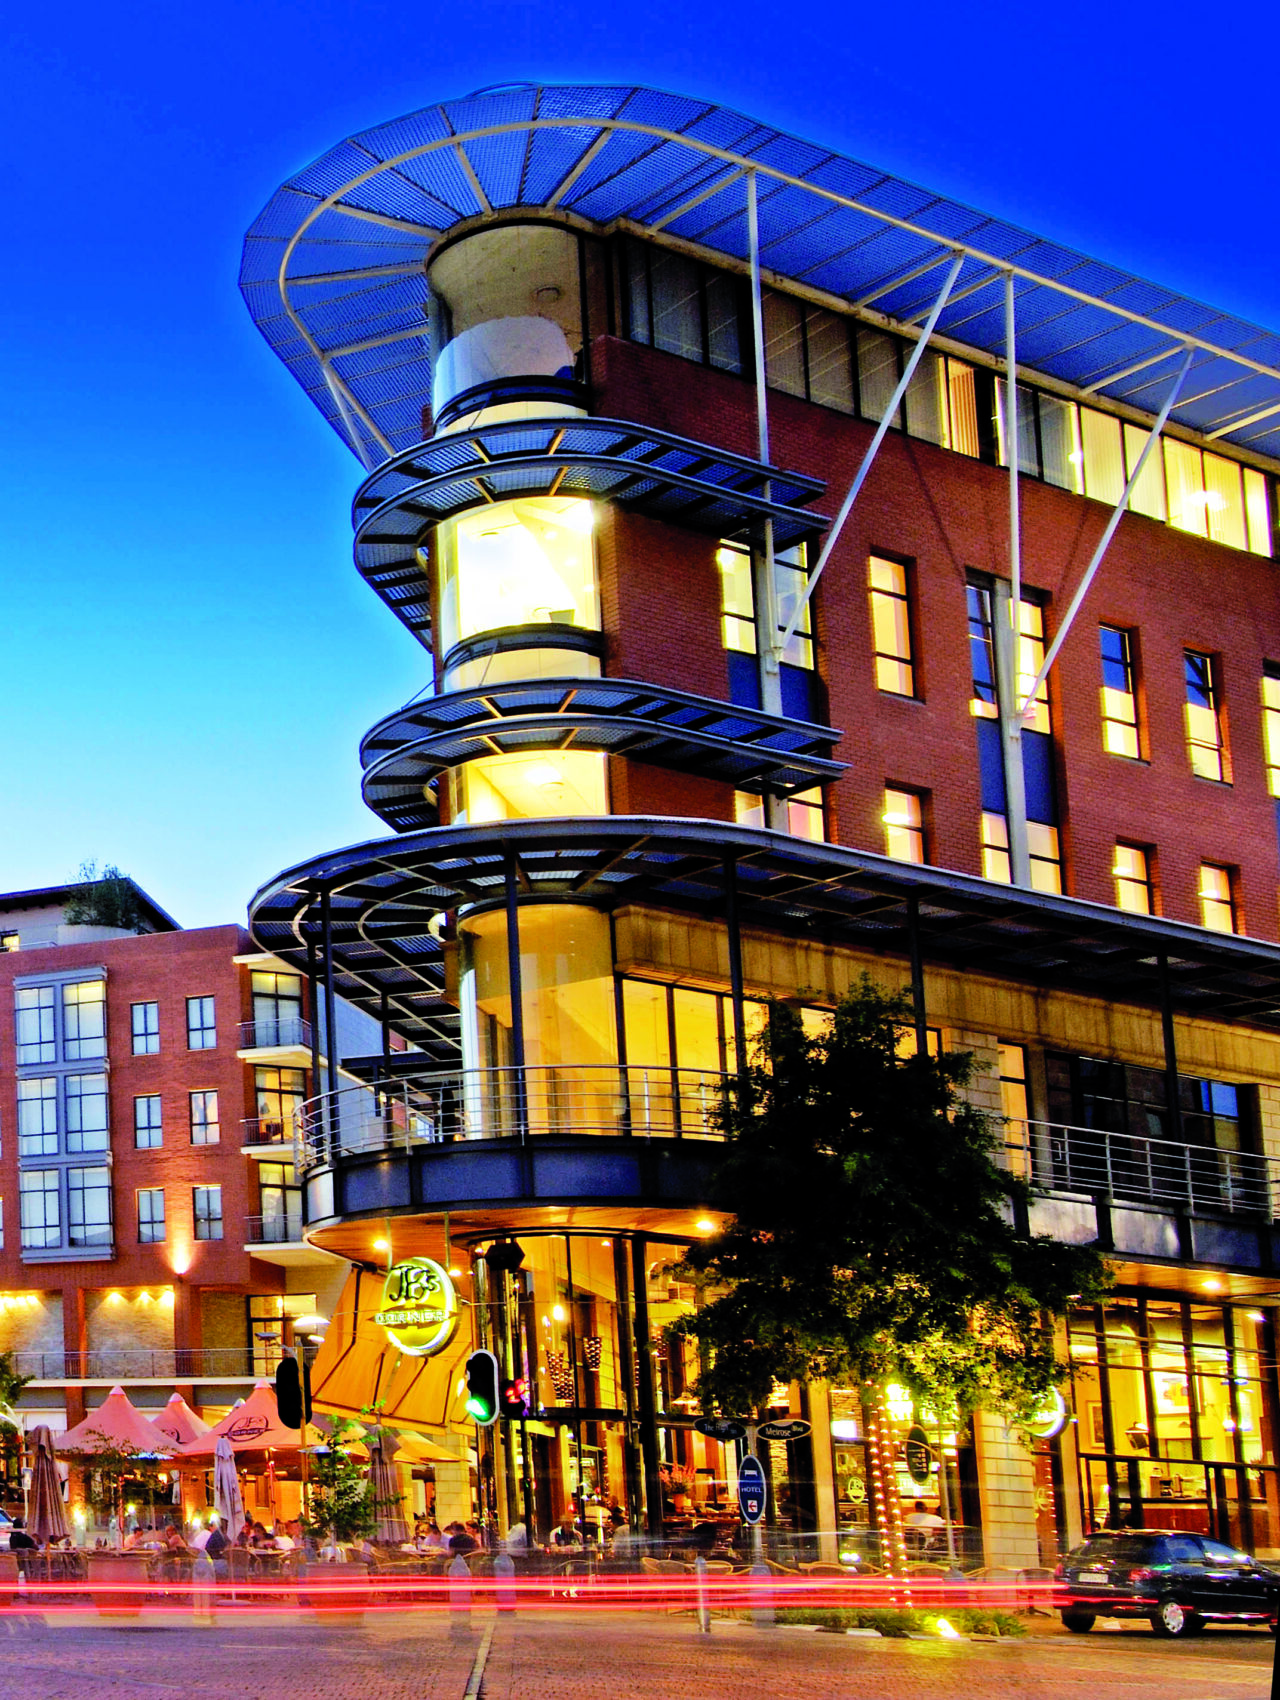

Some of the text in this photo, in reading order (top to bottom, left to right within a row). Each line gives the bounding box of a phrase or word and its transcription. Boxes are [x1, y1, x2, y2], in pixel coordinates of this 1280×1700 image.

[388, 1265, 439, 1302] JB's
[375, 1309, 445, 1324] CORNER
[765, 1427, 791, 1437] Melrose
